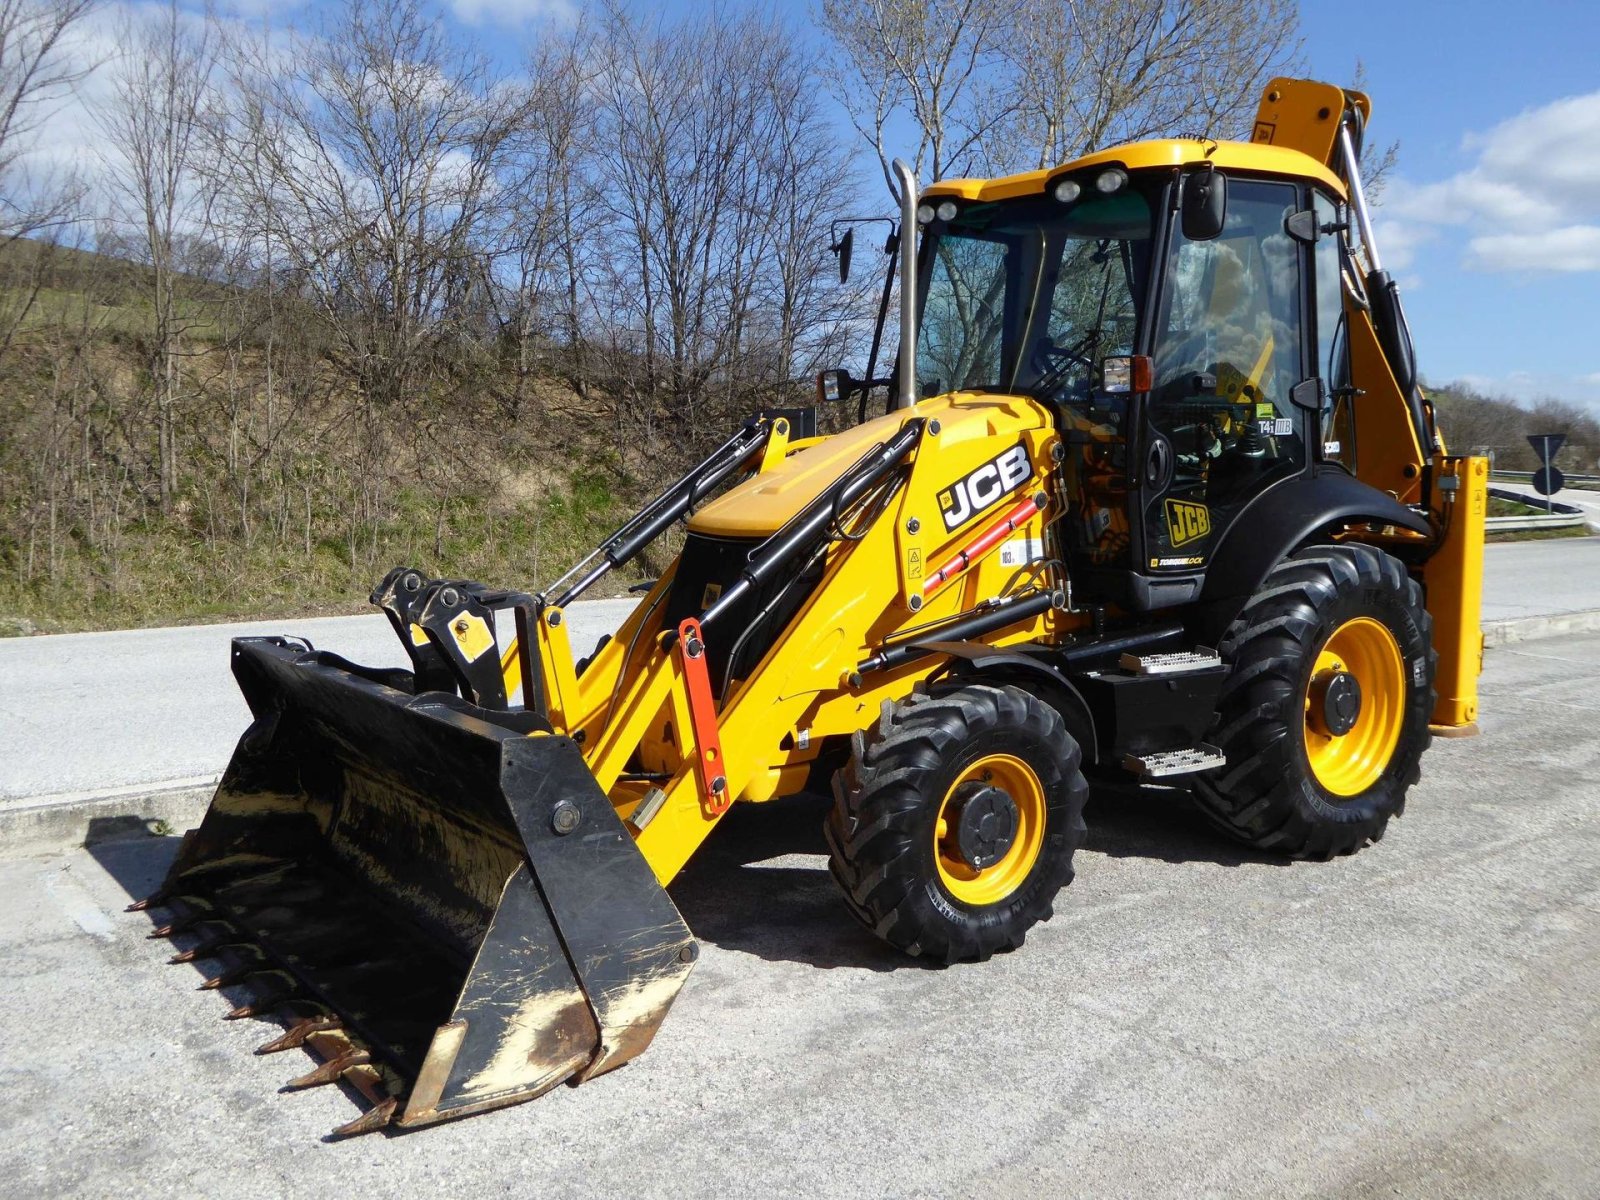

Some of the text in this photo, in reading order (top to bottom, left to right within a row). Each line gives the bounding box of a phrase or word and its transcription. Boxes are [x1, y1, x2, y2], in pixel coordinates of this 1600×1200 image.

[1259, 421, 1275, 434] T4i
[944, 445, 1031, 528] JCB
[1172, 504, 1208, 542] JCB
[1002, 551, 1012, 564] 103
